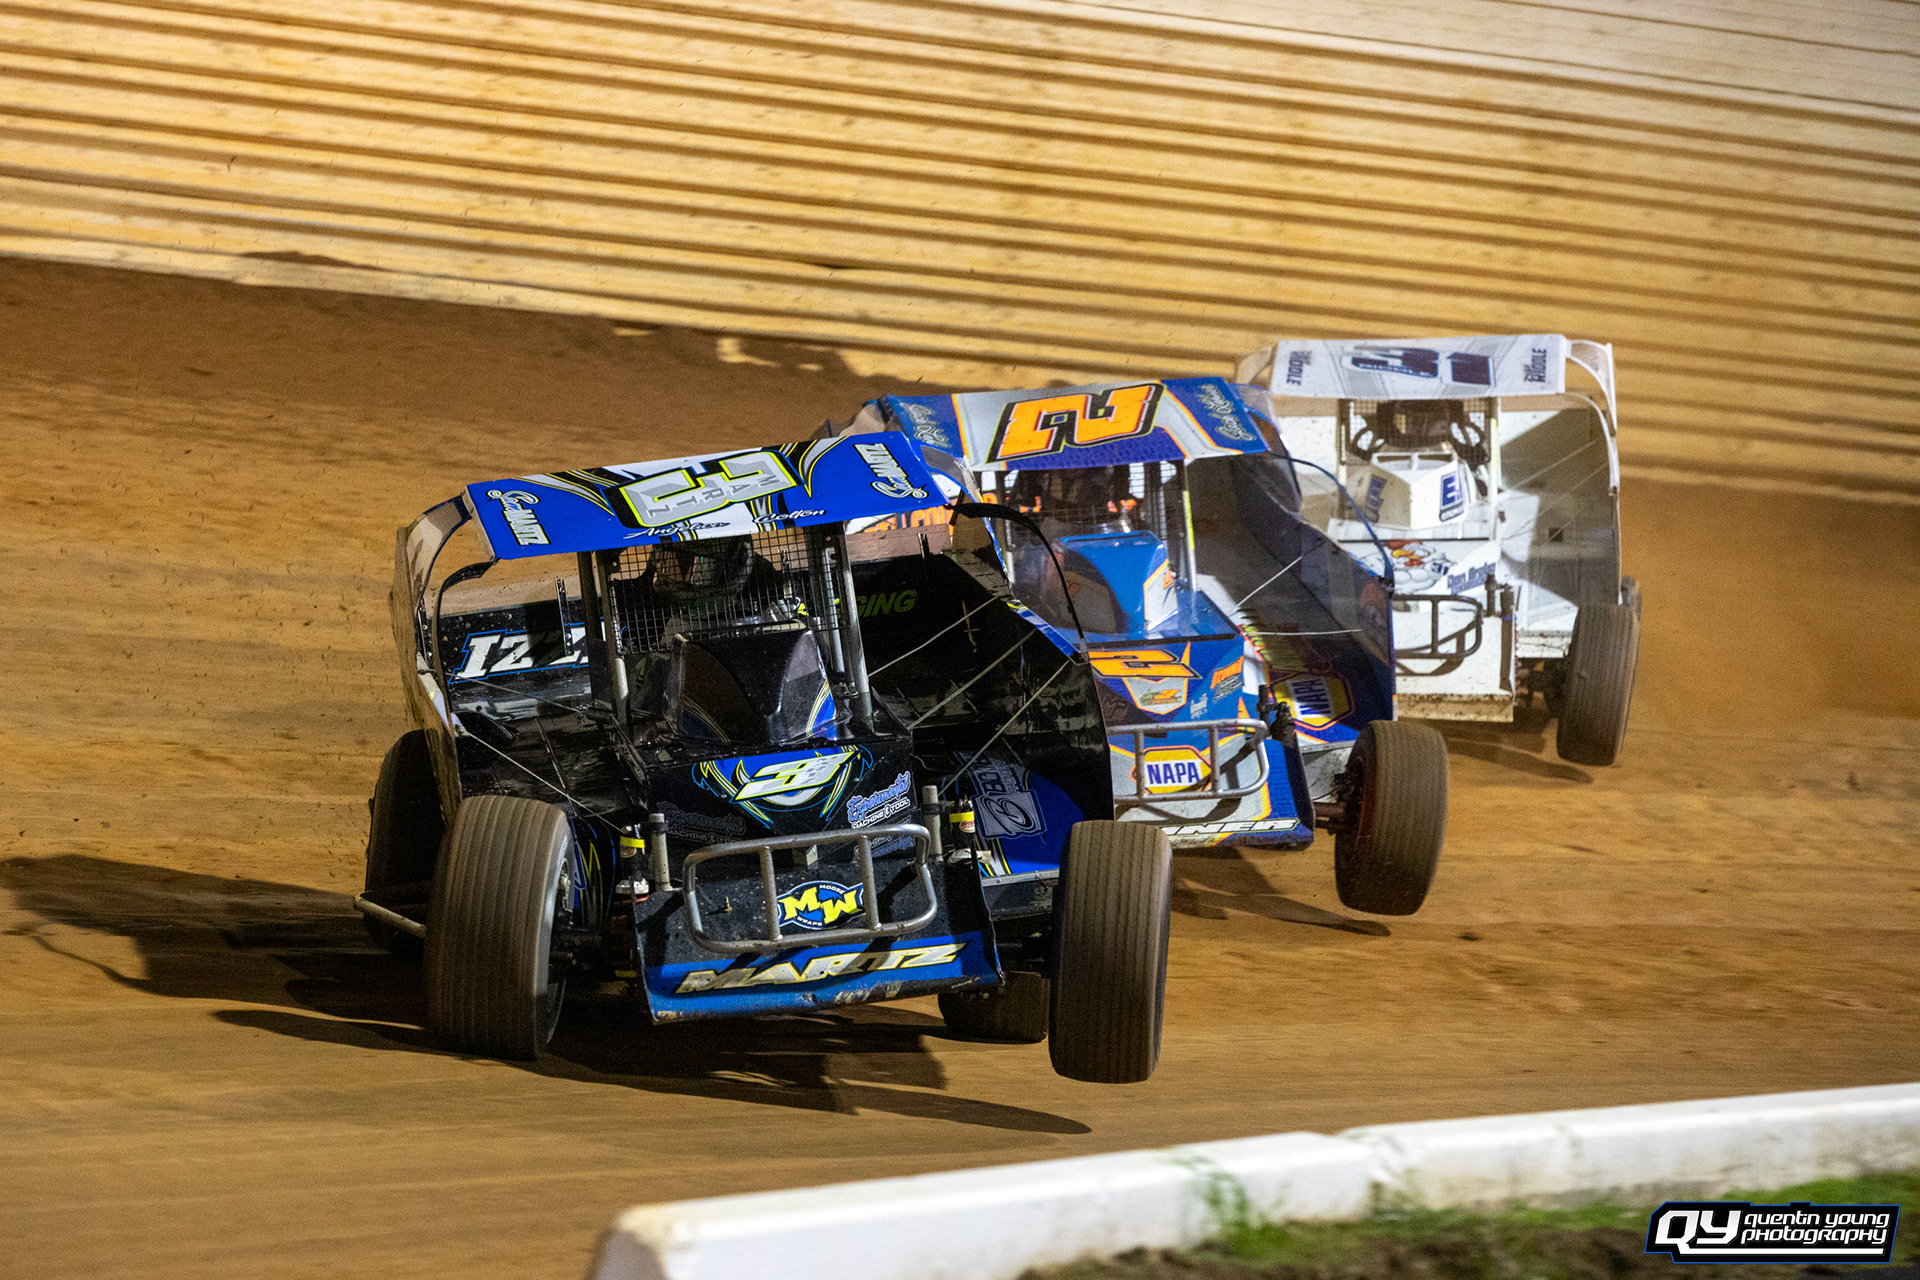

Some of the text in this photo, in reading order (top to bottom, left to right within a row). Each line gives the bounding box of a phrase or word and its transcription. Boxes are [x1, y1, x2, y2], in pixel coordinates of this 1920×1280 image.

[988, 383, 1164, 462] 2
[752, 508, 827, 524] Colton
[1086, 649, 1200, 679] 2
[1291, 678, 1332, 716] NAPA
[1147, 761, 1201, 785] NAPA
[851, 811, 884, 829] MACHINE
[890, 798, 910, 814] TOOL
[1161, 818, 1300, 836] NER
[819, 884, 846, 895] MOOSE
[797, 916, 823, 927] WRAPS
[674, 942, 970, 994] MARTZ
